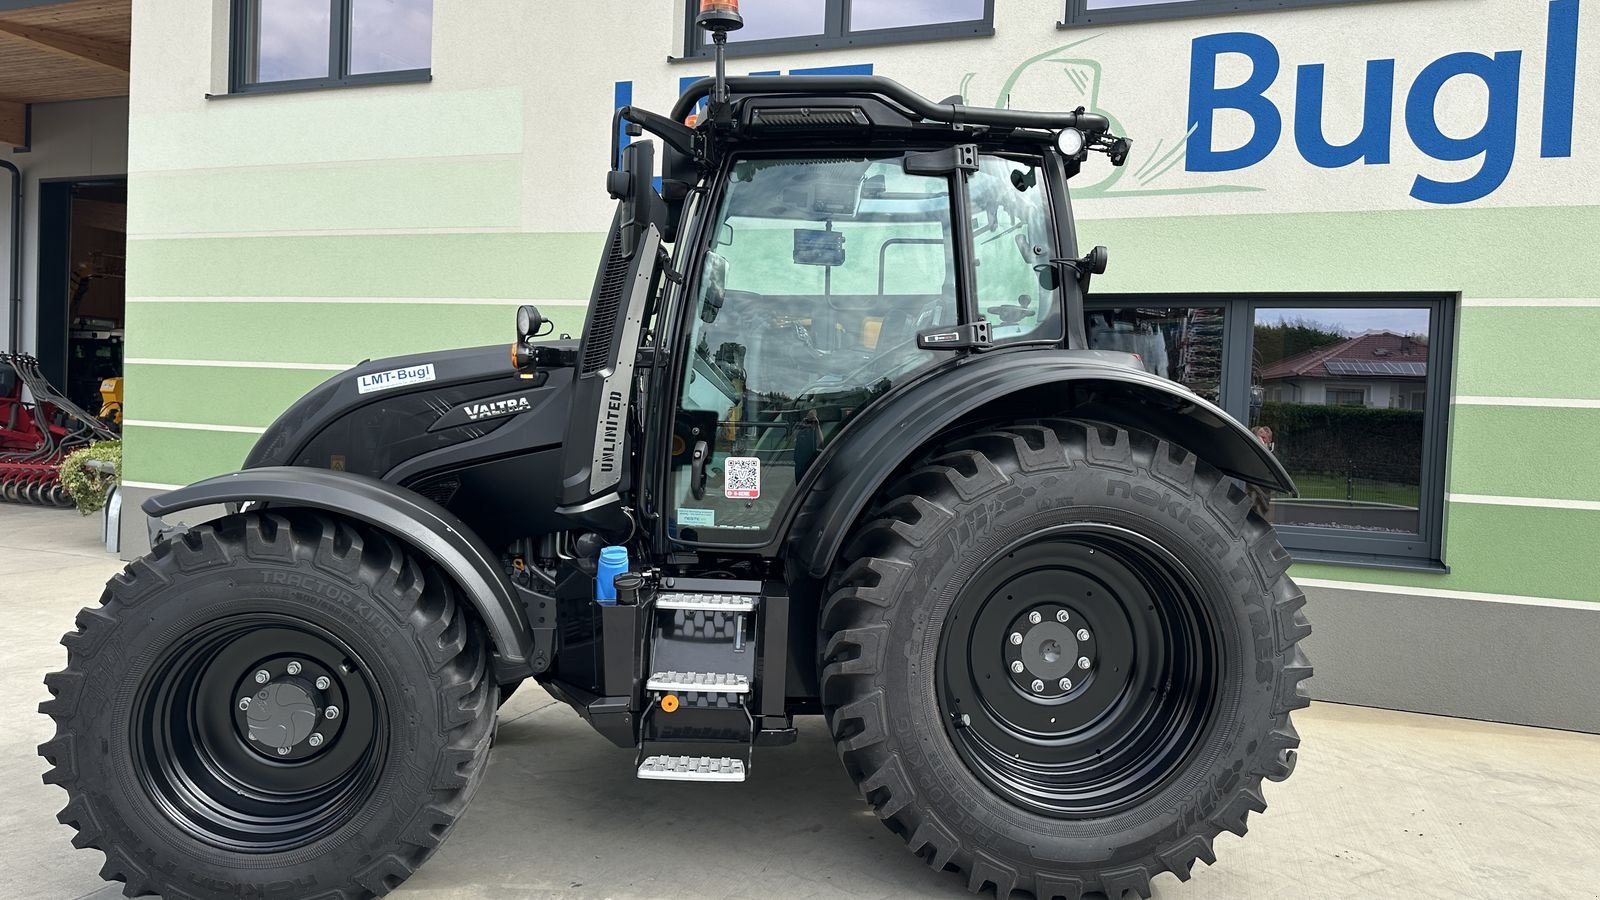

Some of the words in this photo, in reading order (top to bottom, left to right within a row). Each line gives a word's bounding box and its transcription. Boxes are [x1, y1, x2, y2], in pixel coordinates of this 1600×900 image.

[1185, 0, 1580, 204] Bugl
[362, 365, 430, 387] LMT-Bugl
[463, 396, 531, 420] VALTRA
[601, 391, 622, 472] UNLIMITED
[260, 571, 353, 606] TRACTOR
[353, 602, 395, 639] KING
[1106, 479, 1230, 560] nokian
[1230, 557, 1275, 684] TYRES
